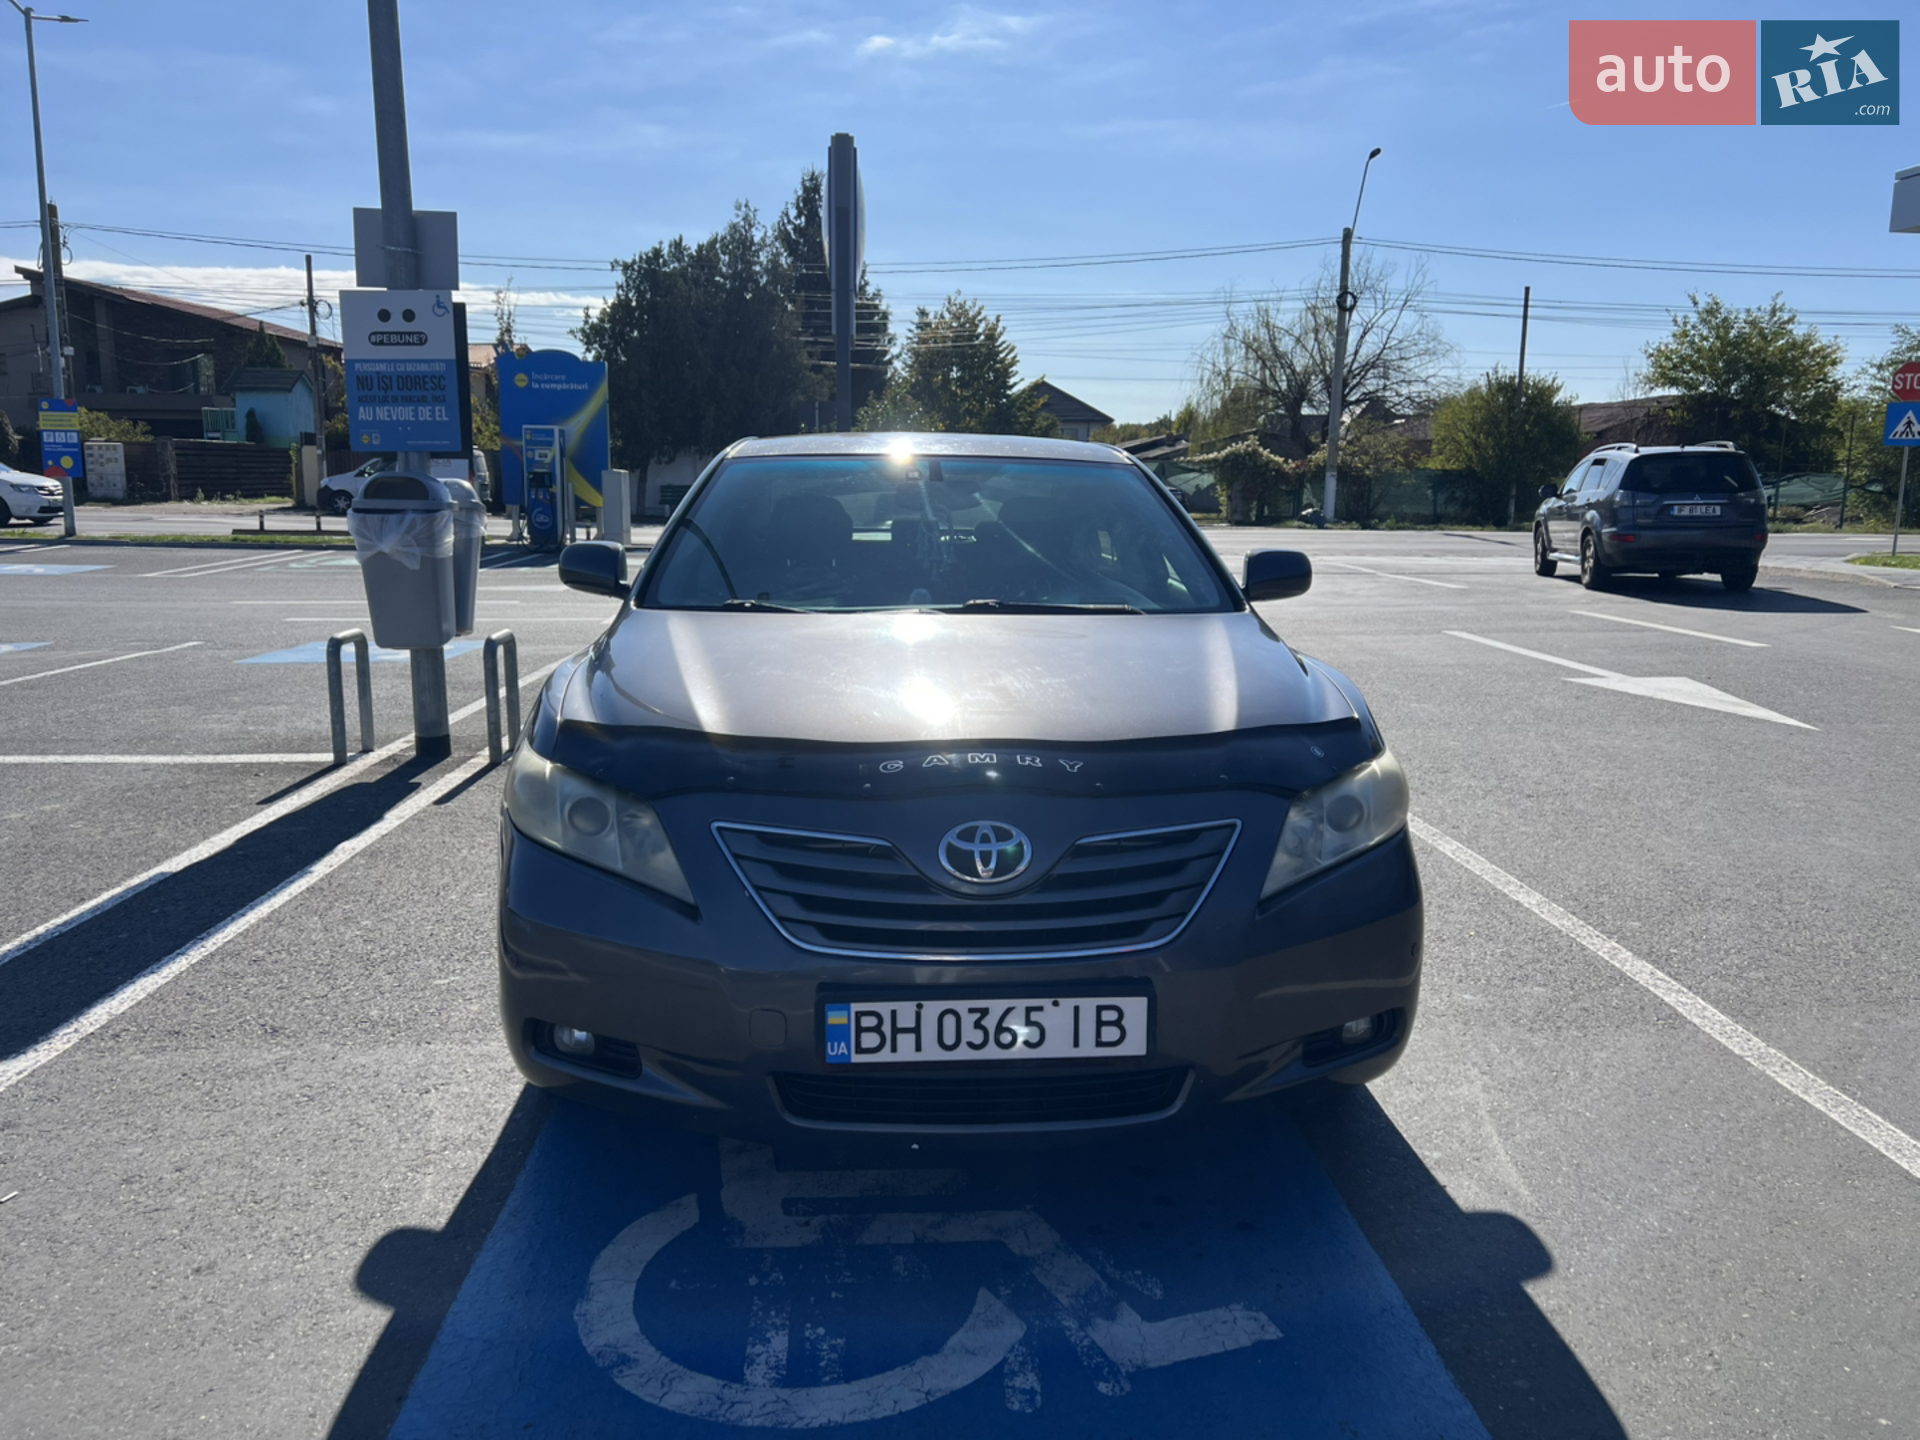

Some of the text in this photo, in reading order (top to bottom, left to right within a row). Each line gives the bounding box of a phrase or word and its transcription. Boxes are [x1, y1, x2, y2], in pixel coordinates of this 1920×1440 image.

[370, 334, 426, 344] #PEBUNE?
[356, 374, 374, 392] NU
[396, 374, 446, 392] DORESC
[358, 406, 449, 421] AU NEVOIE DE EL
[878, 752, 1084, 773] CAMRY
[854, 1004, 1127, 1055] BH 0365 IB
[827, 1042, 848, 1056] UA
